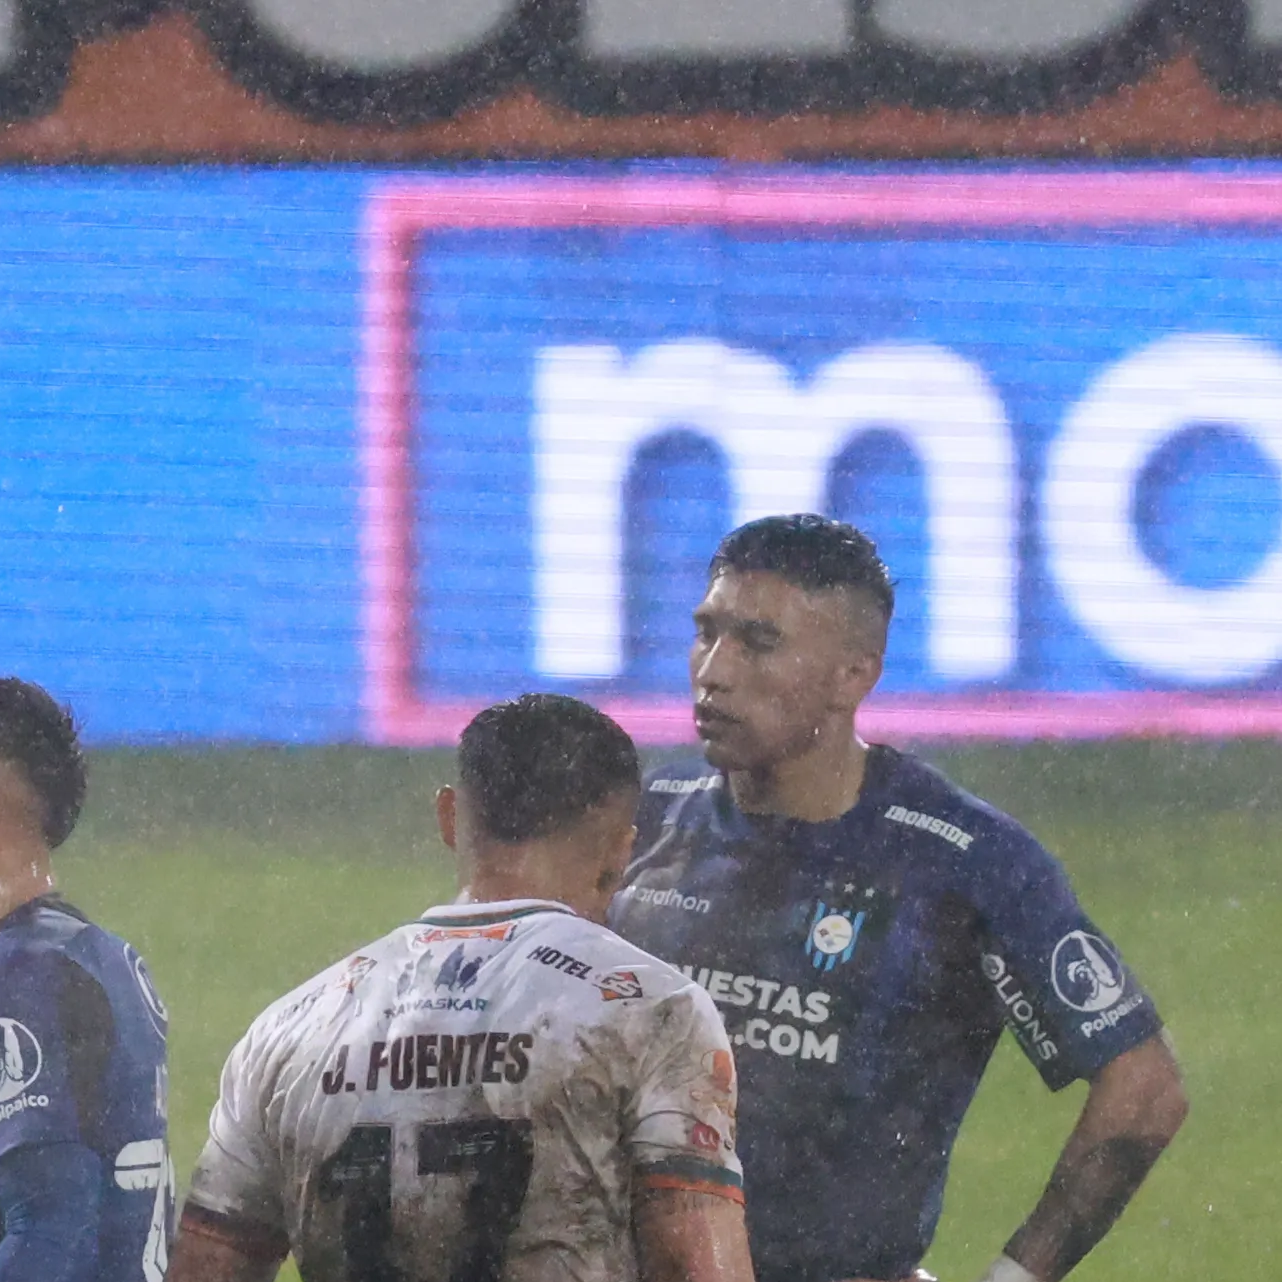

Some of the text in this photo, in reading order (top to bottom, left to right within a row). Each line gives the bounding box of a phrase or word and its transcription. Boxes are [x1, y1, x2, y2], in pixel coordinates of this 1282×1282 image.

[884, 804, 974, 851] IRONSIDE
[527, 945, 593, 981] HOTEL
[992, 974, 1059, 1061] LIONS
[322, 1032, 533, 1095] J. FUENTES
